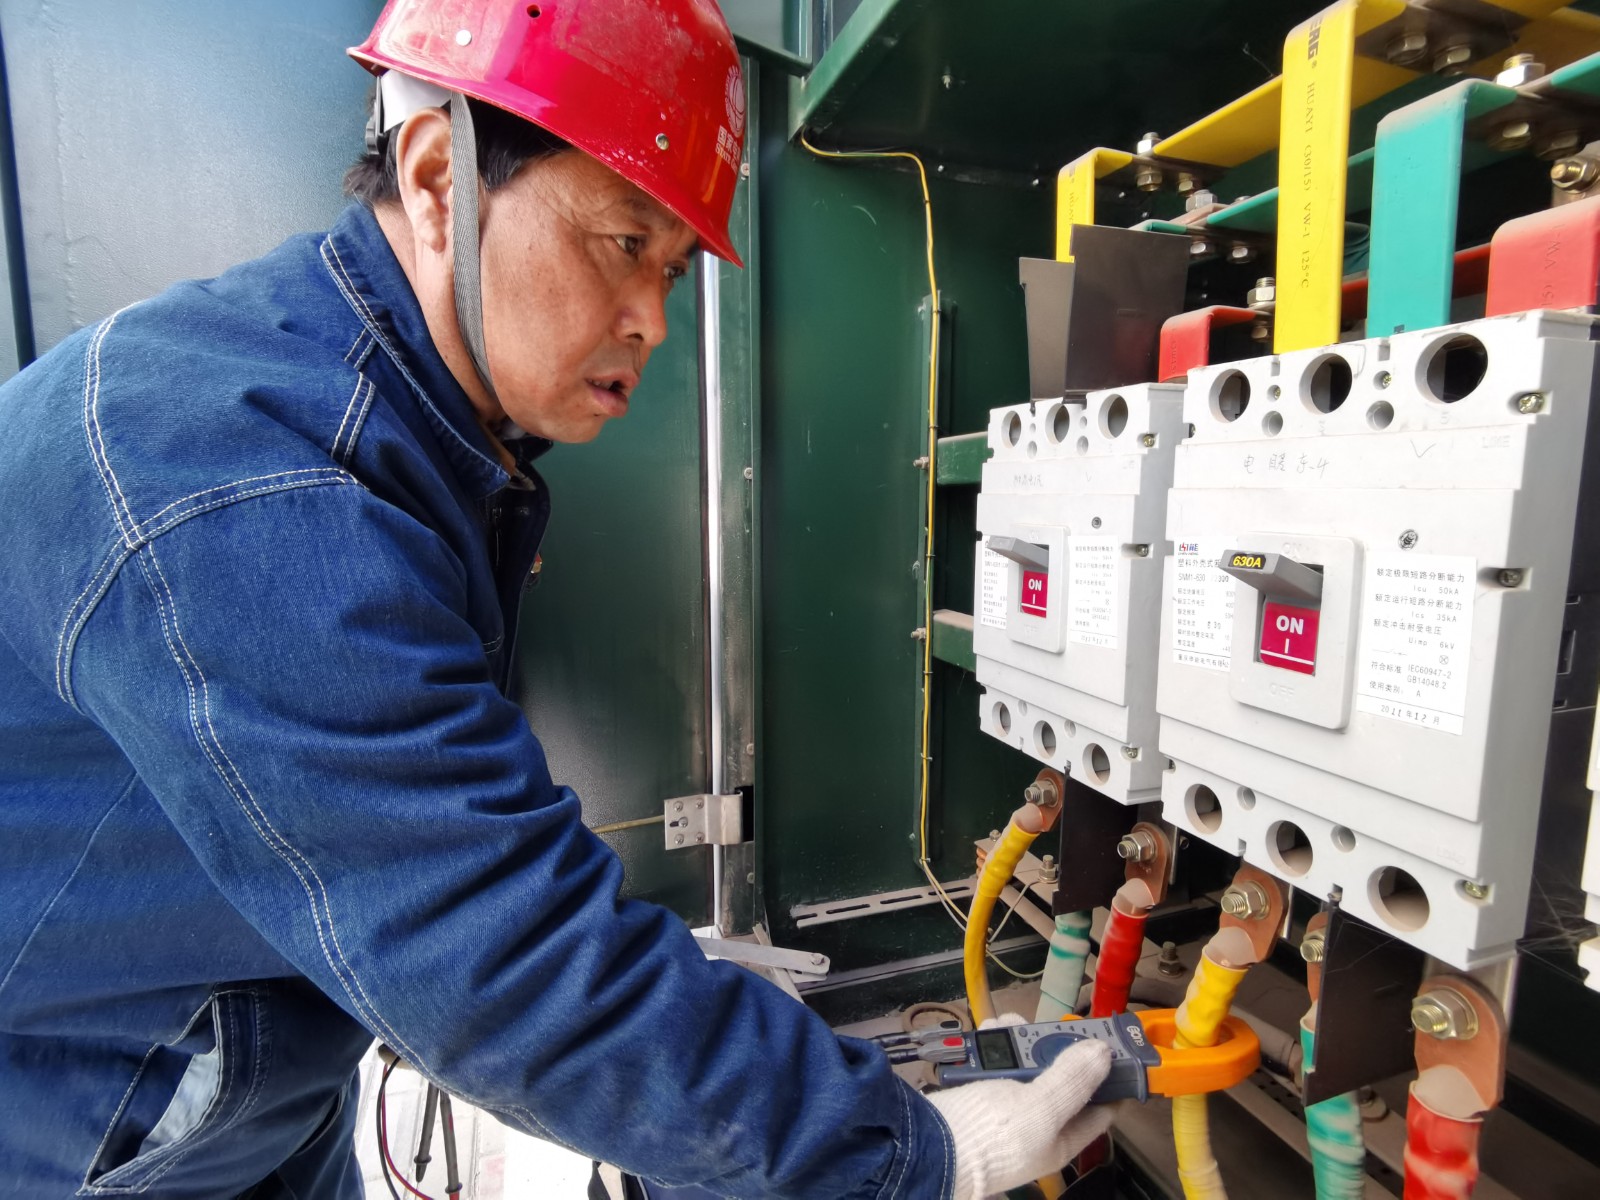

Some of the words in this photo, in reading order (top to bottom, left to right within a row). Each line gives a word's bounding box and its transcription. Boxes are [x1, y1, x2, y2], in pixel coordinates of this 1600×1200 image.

[1232, 555, 1262, 568] 630A
[1028, 578, 1043, 592] ON
[1276, 615, 1304, 635] ON
[1408, 664, 1452, 680] IEC60947-2
